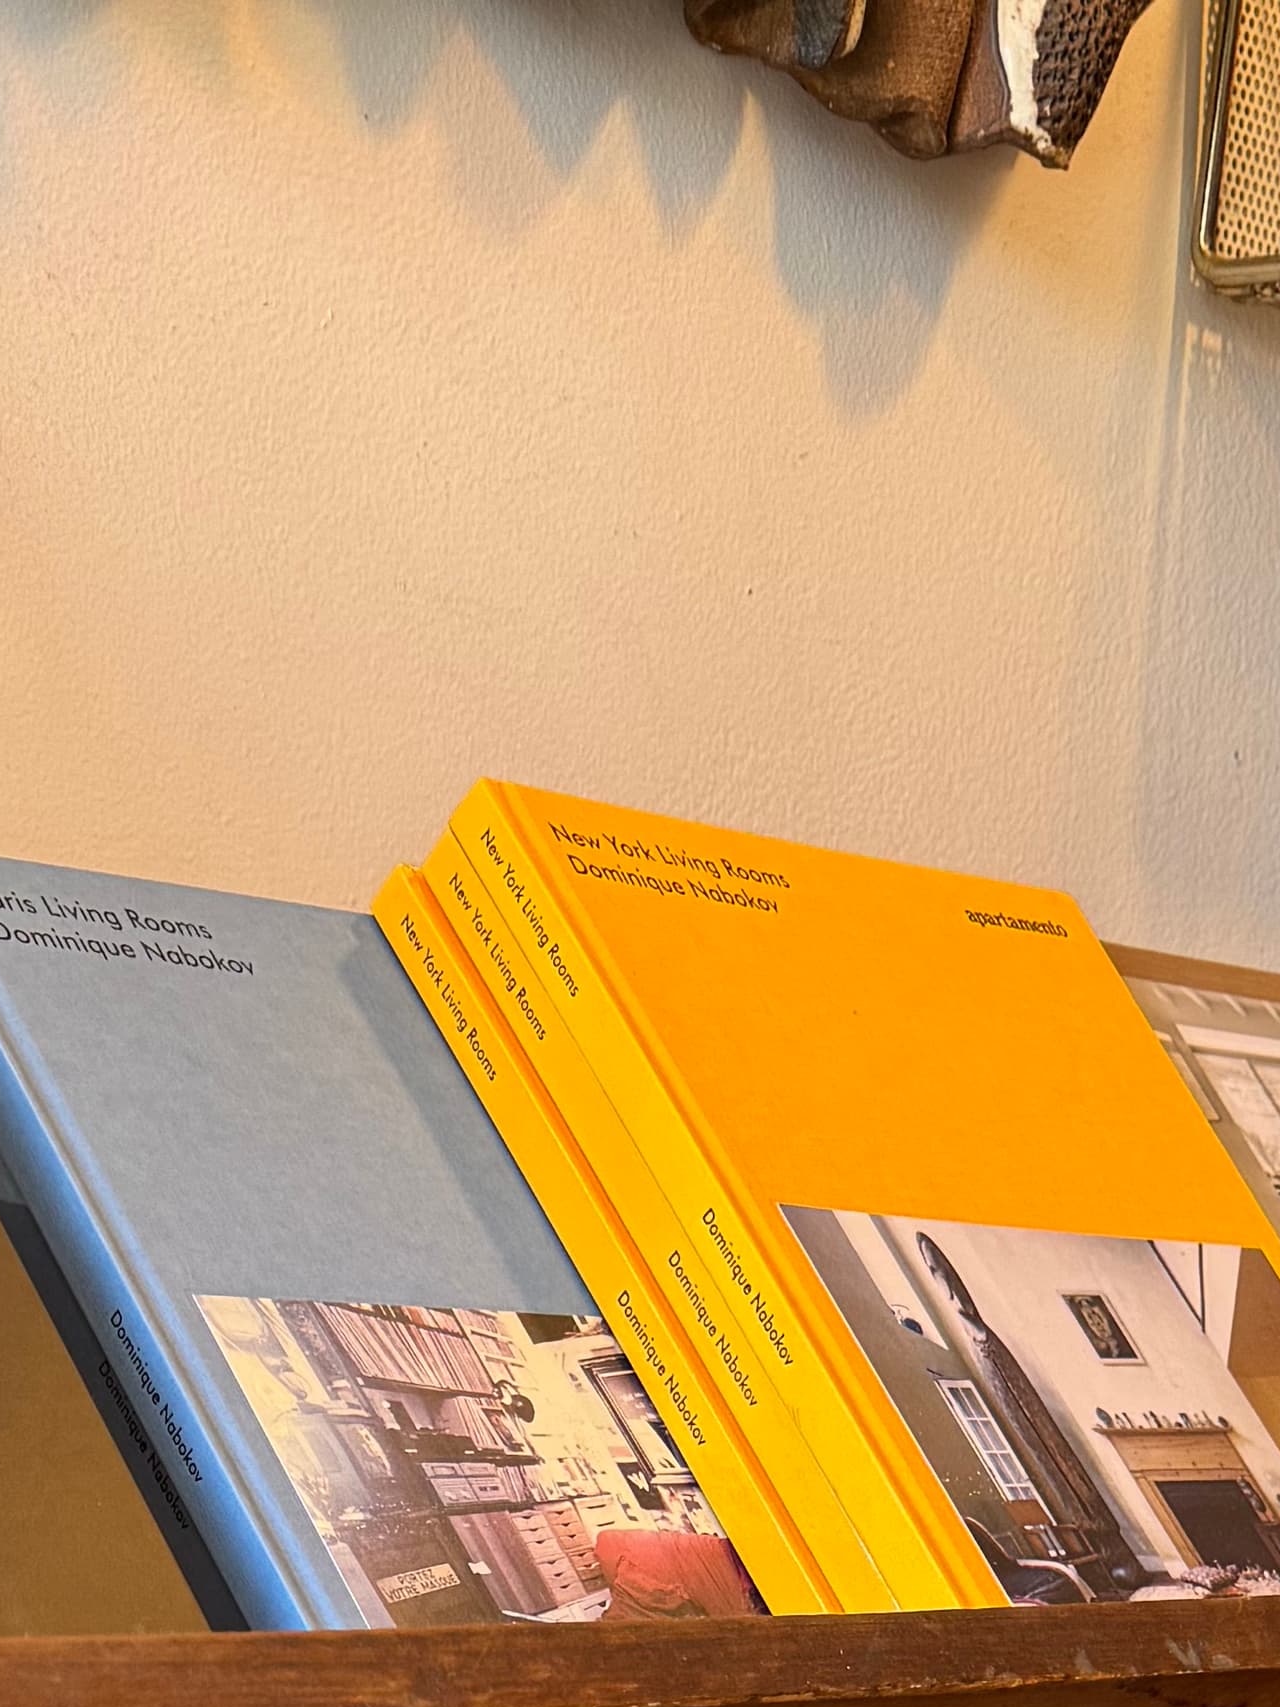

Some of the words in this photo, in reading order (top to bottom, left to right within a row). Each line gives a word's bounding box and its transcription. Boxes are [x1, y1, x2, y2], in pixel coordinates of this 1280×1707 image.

[41, 895, 122, 931] Living
[124, 908, 213, 940] Rooms
[480, 827, 504, 865] New
[502, 863, 524, 903] York
[521, 898, 549, 949] Living
[547, 943, 579, 998] Rooms
[548, 821, 601, 850] New
[602, 832, 657, 862] York
[655, 844, 721, 880] Living
[720, 858, 790, 889] Rooms
[567, 853, 686, 896] Dominique
[687, 879, 779, 914] Nabokov
[965, 909, 1068, 938] apartamento
[140, 940, 254, 976] Nabokov
[400, 914, 424, 951] New
[422, 948, 444, 988] York
[440, 983, 468, 1033] Living
[466, 1027, 497, 1082] Rooms
[449, 872, 472, 911] New
[470, 908, 493, 947] York
[489, 942, 517, 993] Living
[515, 987, 547, 1041] Rooms
[667, 1249, 717, 1338] Dominique
[715, 1334, 758, 1408] Nabokov
[702, 1207, 752, 1296] Dominique
[750, 1293, 794, 1366] Nabokov
[98, 1360, 146, 1453] Dominique
[146, 1449, 191, 1530] Nabokov
[110, 1308, 160, 1407] Dominique
[159, 1402, 204, 1483] Nabokov
[617, 1289, 666, 1377] Dominique
[664, 1374, 707, 1448] Nabokov
[385, 1585, 420, 1601] VOTRE
[397, 1568, 433, 1585] PORTEZ
